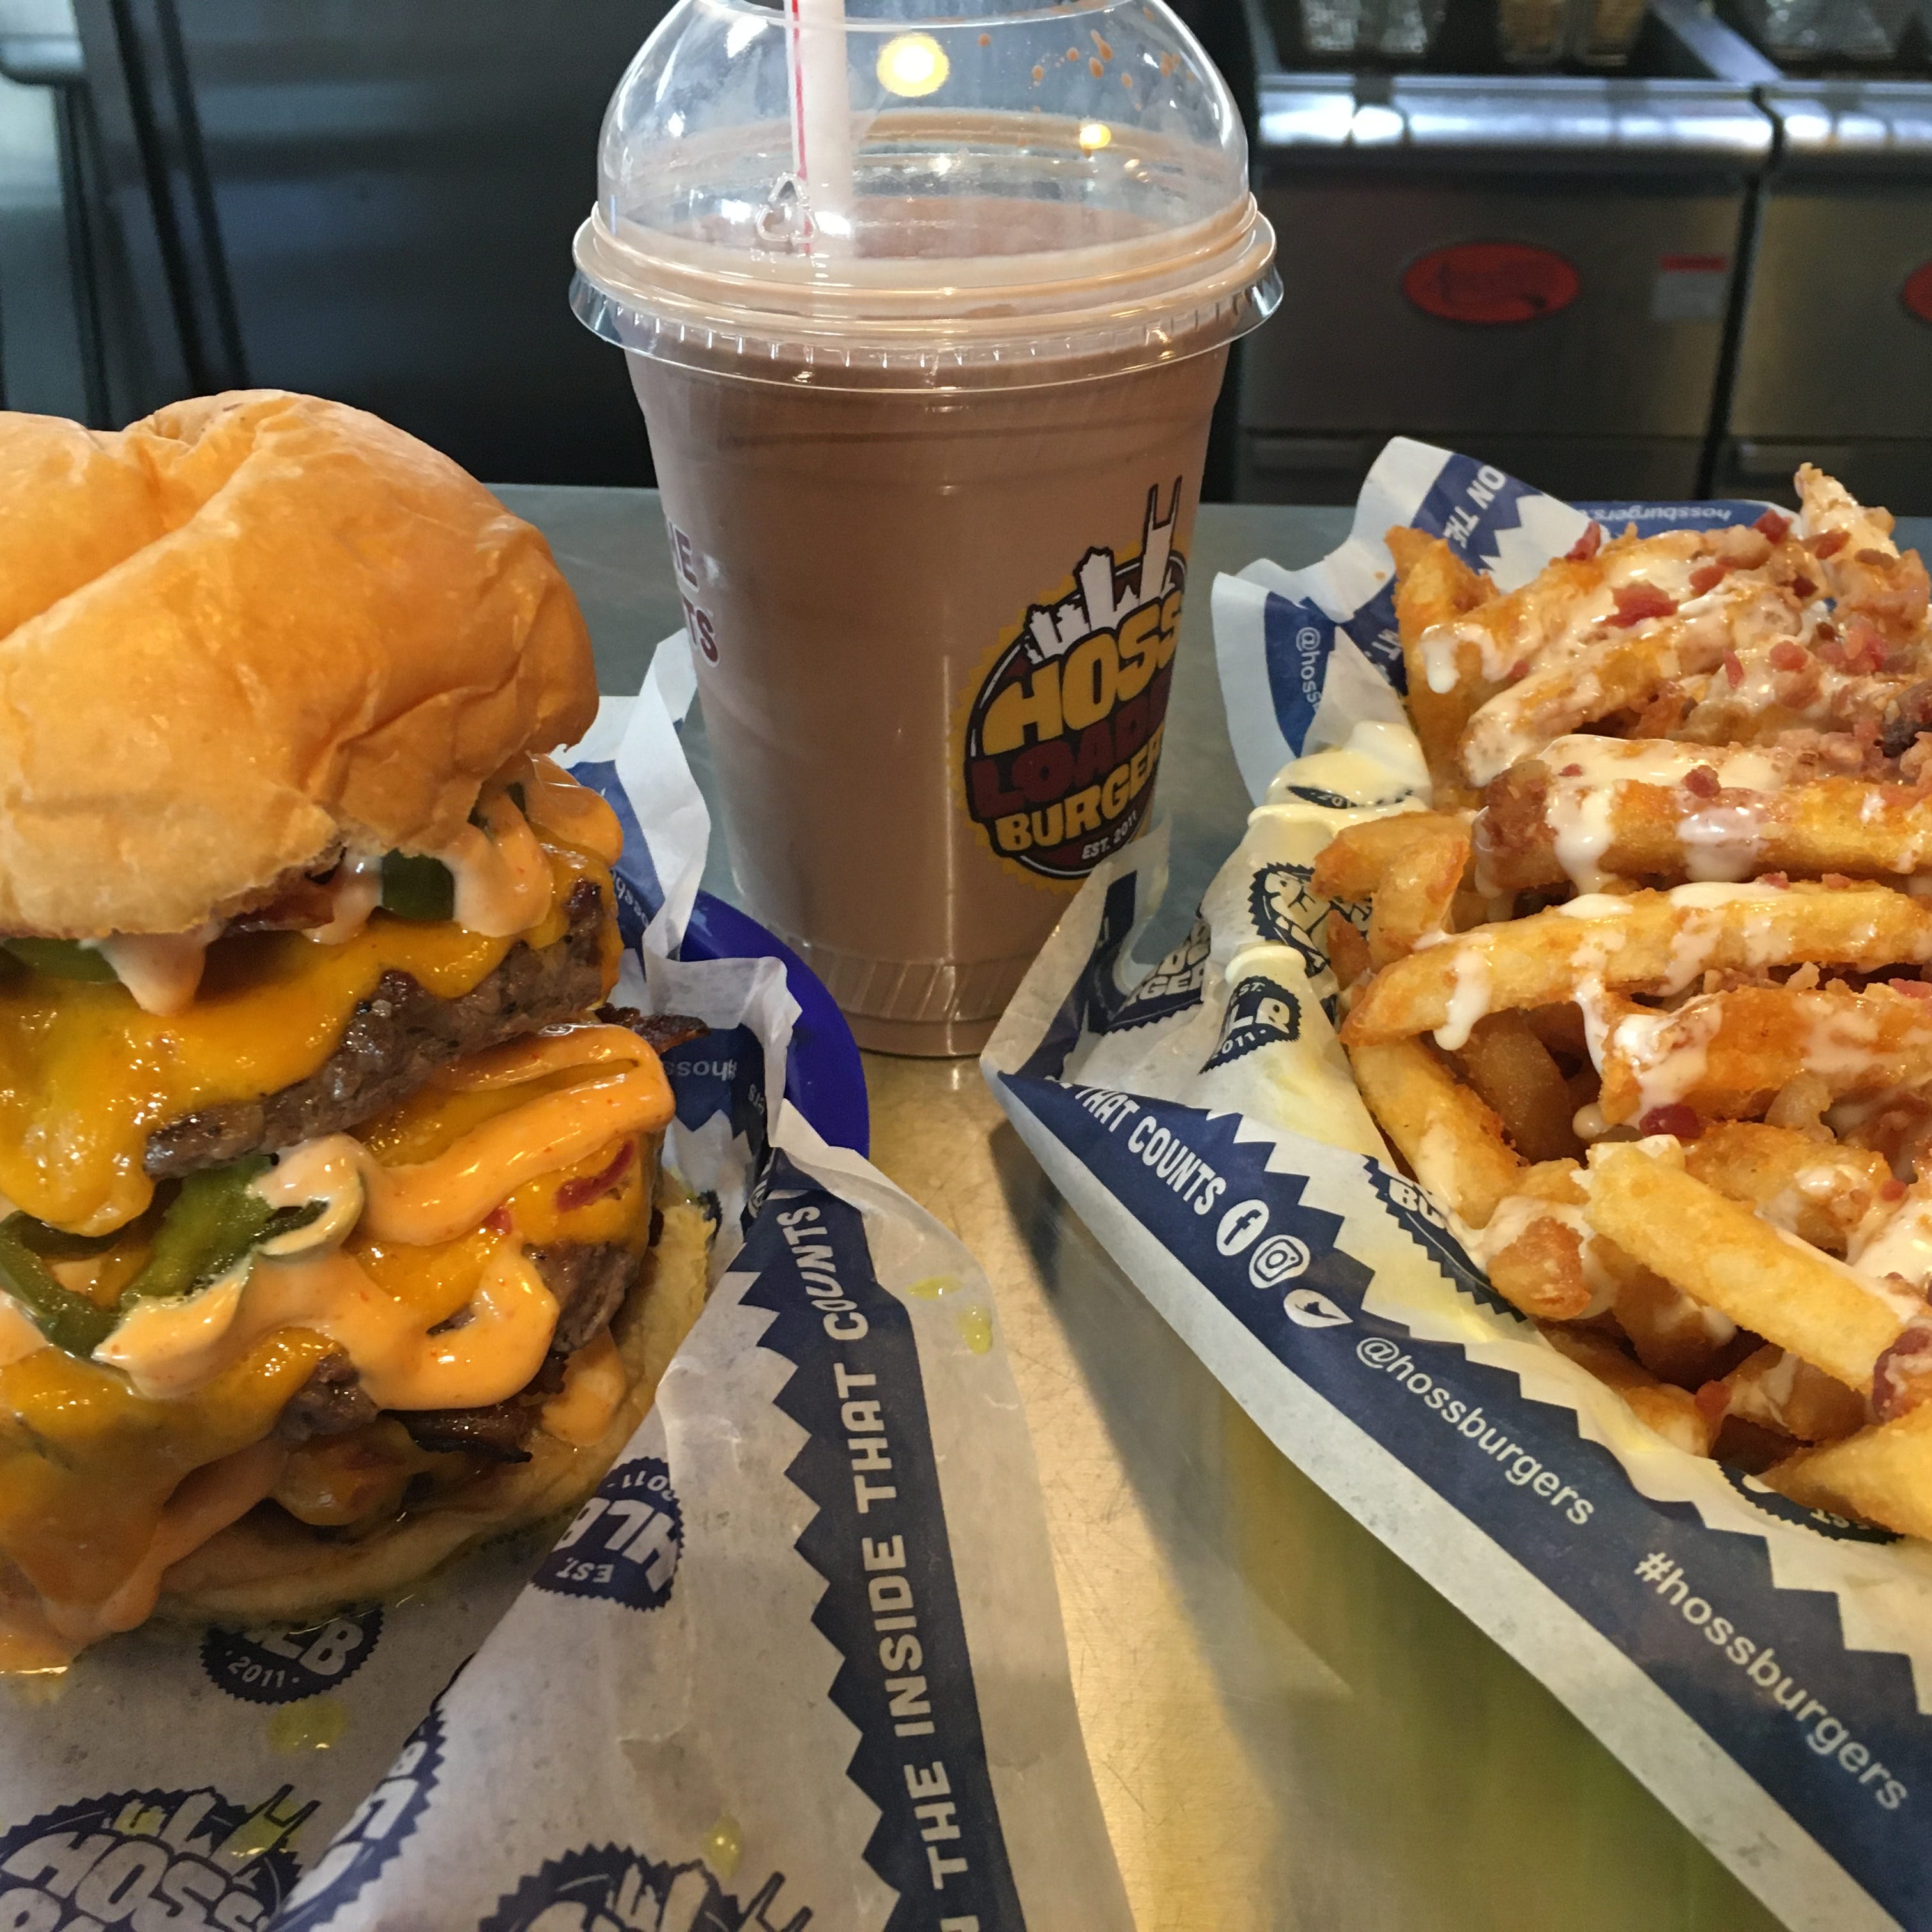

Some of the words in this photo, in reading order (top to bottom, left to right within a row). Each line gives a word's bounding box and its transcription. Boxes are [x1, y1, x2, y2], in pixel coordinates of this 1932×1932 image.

[1467, 465, 1506, 510] ON
[983, 591, 1182, 755] HOSS
[1081, 837, 1111, 860] EST.
[1113, 809, 1137, 843] 2011
[1212, 1031, 1256, 1059] 011
[1128, 1116, 1227, 1215] COUNTS
[776, 1206, 869, 1340] COUNTS
[833, 1362, 897, 1514] THAT
[1356, 1337, 1595, 1524] @hossburgers
[555, 1557, 615, 1583] EST.
[227, 1656, 286, 1688] 2011
[862, 1535, 935, 1736] INSIDE
[1634, 1552, 1908, 1811] #hossburgers
[903, 1761, 968, 1890] THE
